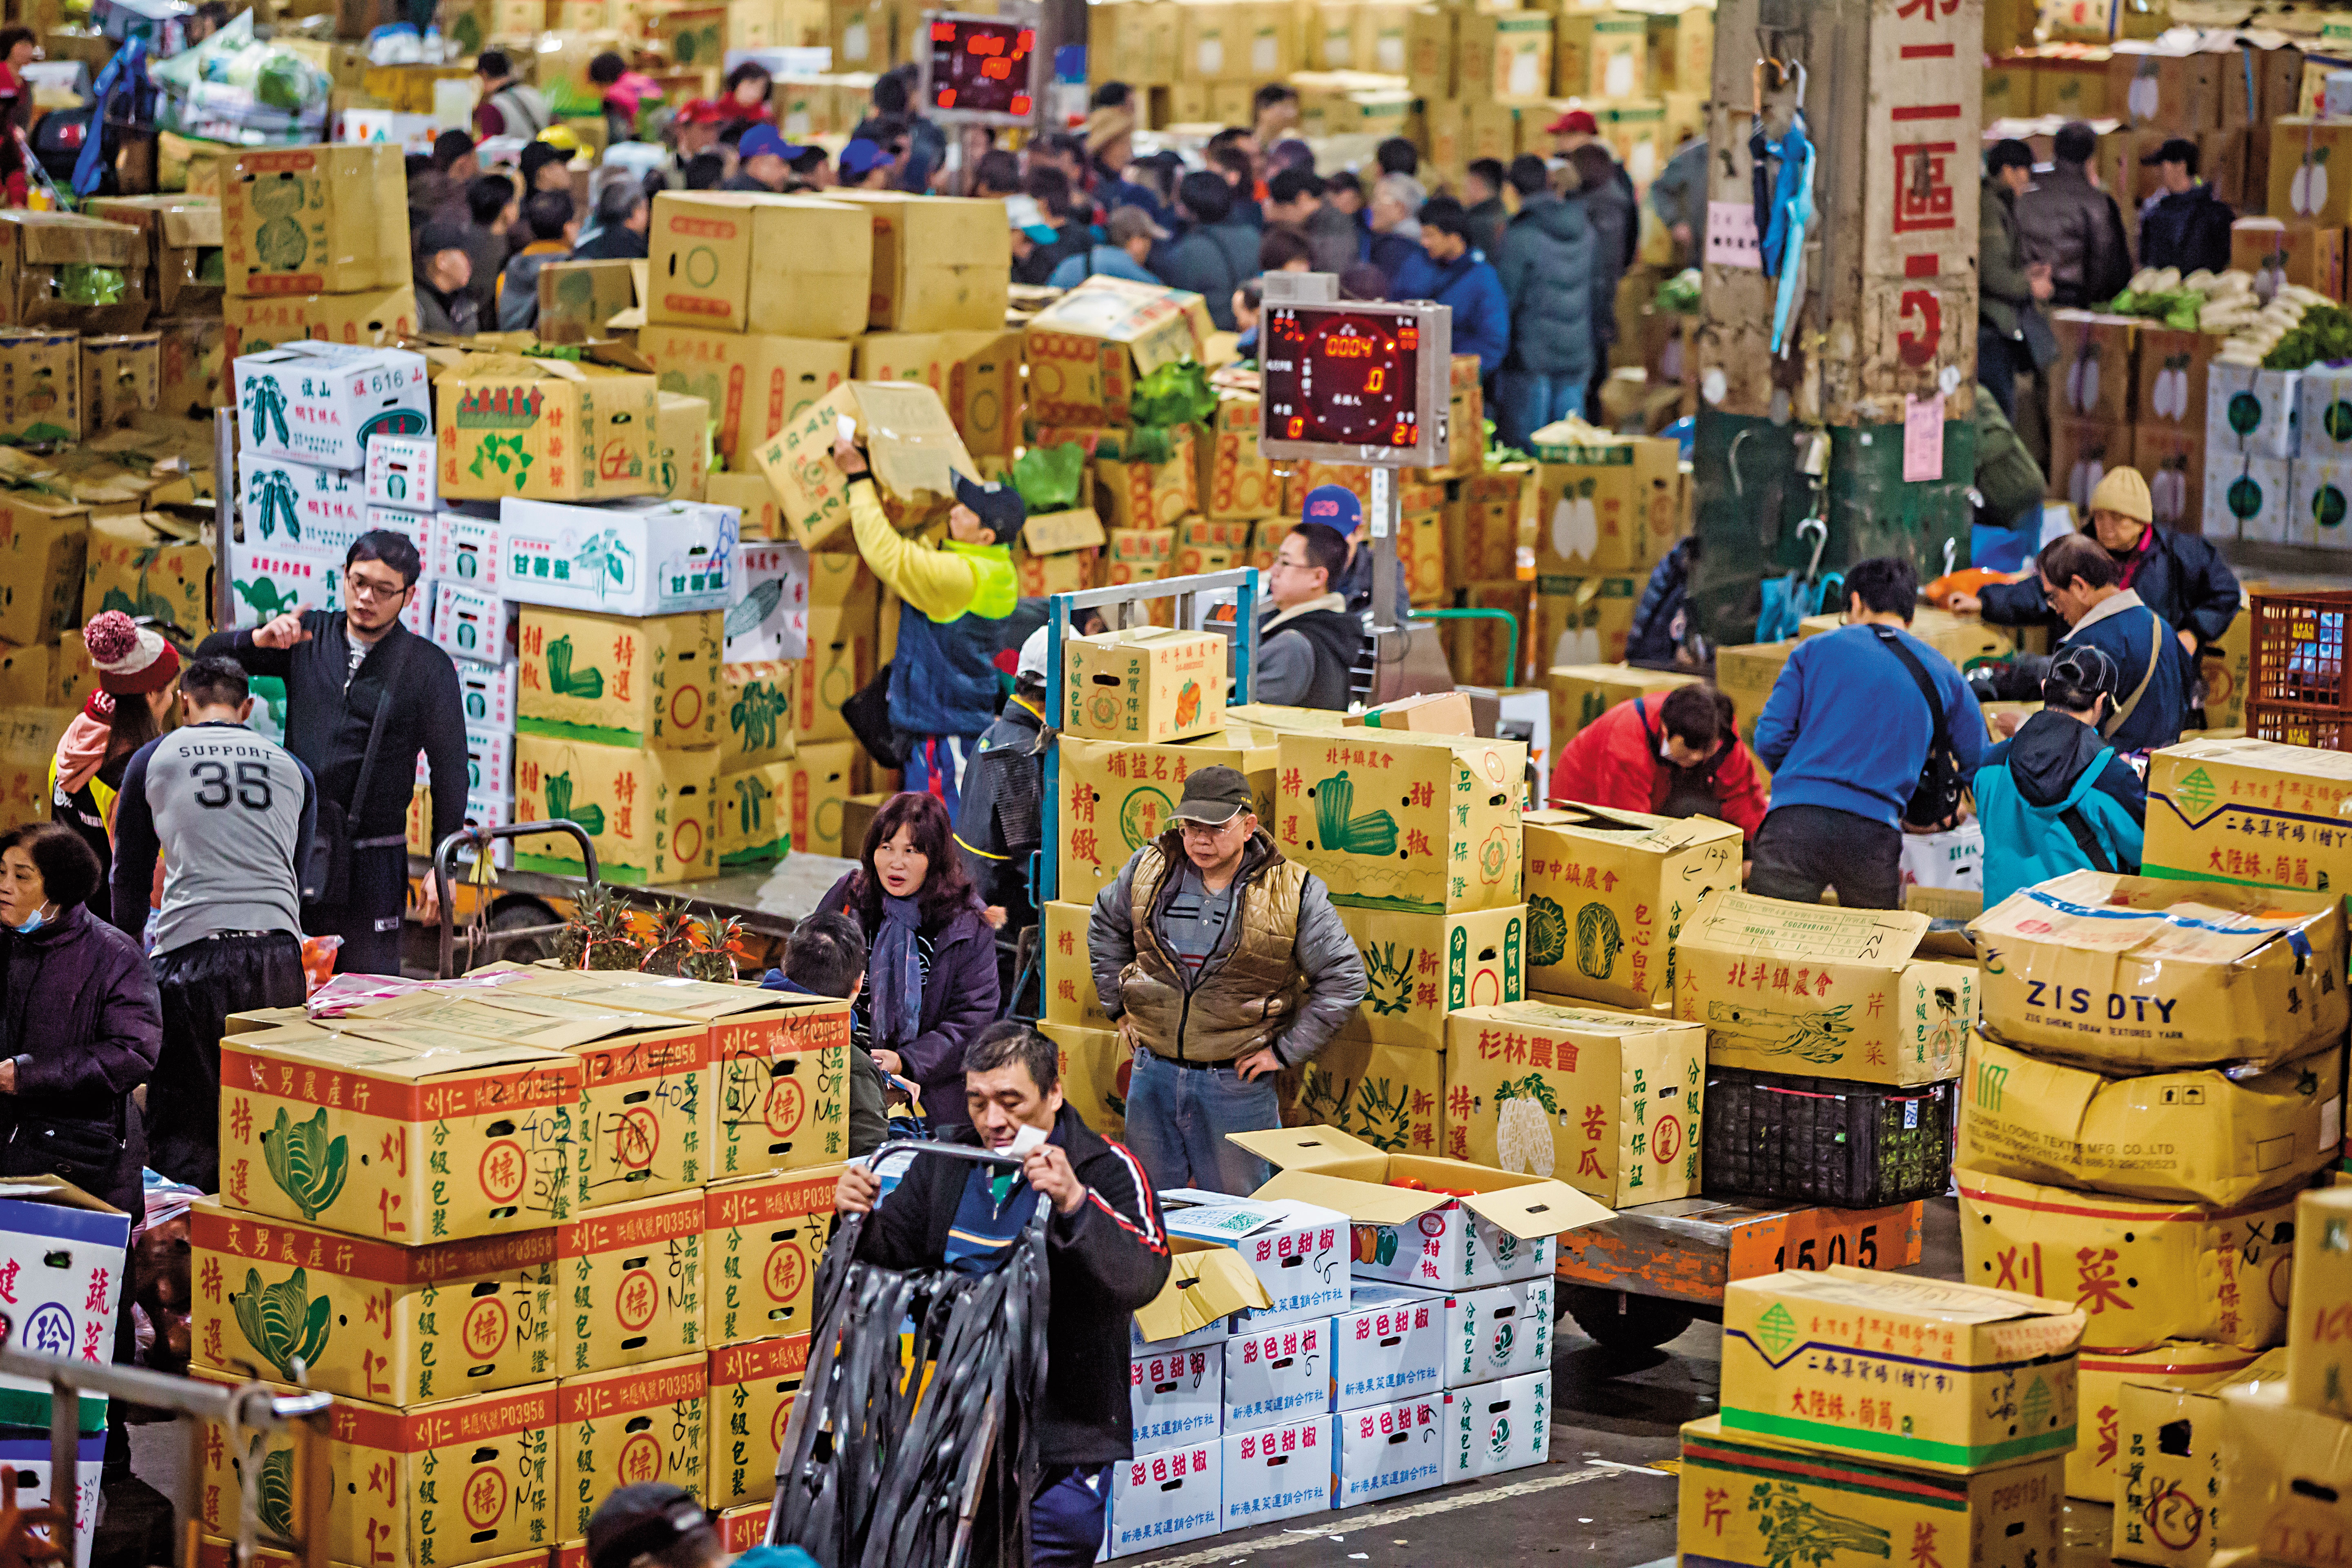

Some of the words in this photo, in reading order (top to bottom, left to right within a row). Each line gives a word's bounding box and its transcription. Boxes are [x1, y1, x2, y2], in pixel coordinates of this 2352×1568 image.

[372, 370, 403, 393] 616
[1070, 653, 1083, 726] 分級包裝
[180, 746, 272, 760] SUPPORT
[190, 761, 272, 811] 35
[1281, 768, 1303, 846] 特選
[1408, 781, 1435, 857] 甜椒
[1451, 771, 1471, 898] 品質保證
[1631, 904, 1652, 993] 包心白菜
[1417, 948, 1440, 1010] 新鮮
[1728, 962, 1833, 998] 北斗鎮農會
[2026, 981, 2090, 1014] ZIS
[2107, 993, 2177, 1024] DTY
[724, 1029, 761, 1053] 刈仁
[1865, 992, 1886, 1066] 芹菜
[1916, 981, 1927, 1064] 分級包裝
[1479, 1029, 1580, 1073] 杉林農會
[253, 1063, 370, 1112] 文男農產行
[424, 1088, 466, 1118] 刈仁
[774, 1089, 797, 1125] 標
[825, 1047, 844, 1154] 品質保證
[1411, 1089, 1435, 1150] 新鮮
[1448, 1085, 1473, 1161] 特選
[1577, 1104, 1608, 1179] 苦瓜
[1630, 1069, 1647, 1187] 品質保証
[1686, 1057, 1700, 1180] 分級包裝
[229, 1098, 253, 1206] 特選
[489, 1150, 514, 1188] 標
[379, 1126, 406, 1236] 刈仁
[429, 1119, 451, 1237] 分級包裝
[722, 1195, 760, 1221] 刈仁
[227, 1224, 354, 1273] 文男農產行
[572, 1225, 609, 1252] 刈仁
[1256, 1229, 1334, 1261] 彩色甜椒
[1422, 1239, 1440, 1280] 甜椒
[1775, 1226, 1877, 1272] 1505
[683, 1235, 699, 1344] 品質保證
[725, 1227, 742, 1339] 分級包裝
[773, 1255, 797, 1290] 標
[1996, 1242, 2134, 1315] 刈菜
[82, 1268, 110, 1363] 蔬菜
[200, 1256, 226, 1365] 特選
[531, 1262, 552, 1374] 品質保證
[575, 1255, 593, 1370] 分級包裝
[626, 1282, 648, 1317] 標
[1356, 1307, 1428, 1340] 彩色甜椒
[363, 1287, 392, 1398] 刈仁
[418, 1283, 439, 1399] 分級包裝
[473, 1310, 498, 1347] 標
[1243, 1329, 1316, 1364] 彩色甜椒
[1464, 1302, 1476, 1374] 分級包裝
[726, 1350, 763, 1379] 刈仁
[1345, 1368, 1437, 1396] 新港果菜運銷合作社
[575, 1388, 612, 1415] 刈仁
[1233, 1389, 1324, 1419] 新港果菜運銷合作社
[1361, 1404, 1430, 1439] 彩色甜椒
[416, 1419, 454, 1450] 刈仁
[731, 1383, 749, 1497] 分級包裝
[1241, 1426, 1316, 1459] 彩色甜椒
[1460, 1397, 1472, 1469] 分級包裝
[530, 1429, 547, 1543] 品質保證
[577, 1420, 596, 1534] 分級包裝
[628, 1445, 650, 1480] 標
[1131, 1450, 1206, 1486] 彩色甜椒
[1351, 1464, 1437, 1494] 新港果菜運銷合作社
[366, 1456, 396, 1566] 刈仁
[419, 1449, 439, 1566] 分級包裝
[472, 1478, 497, 1515] 標
[1231, 1486, 1323, 1517] 新港果菜運銷合作社
[1705, 1488, 1730, 1537] 芹
[1122, 1511, 1215, 1544] 新港果菜運銷合作社
